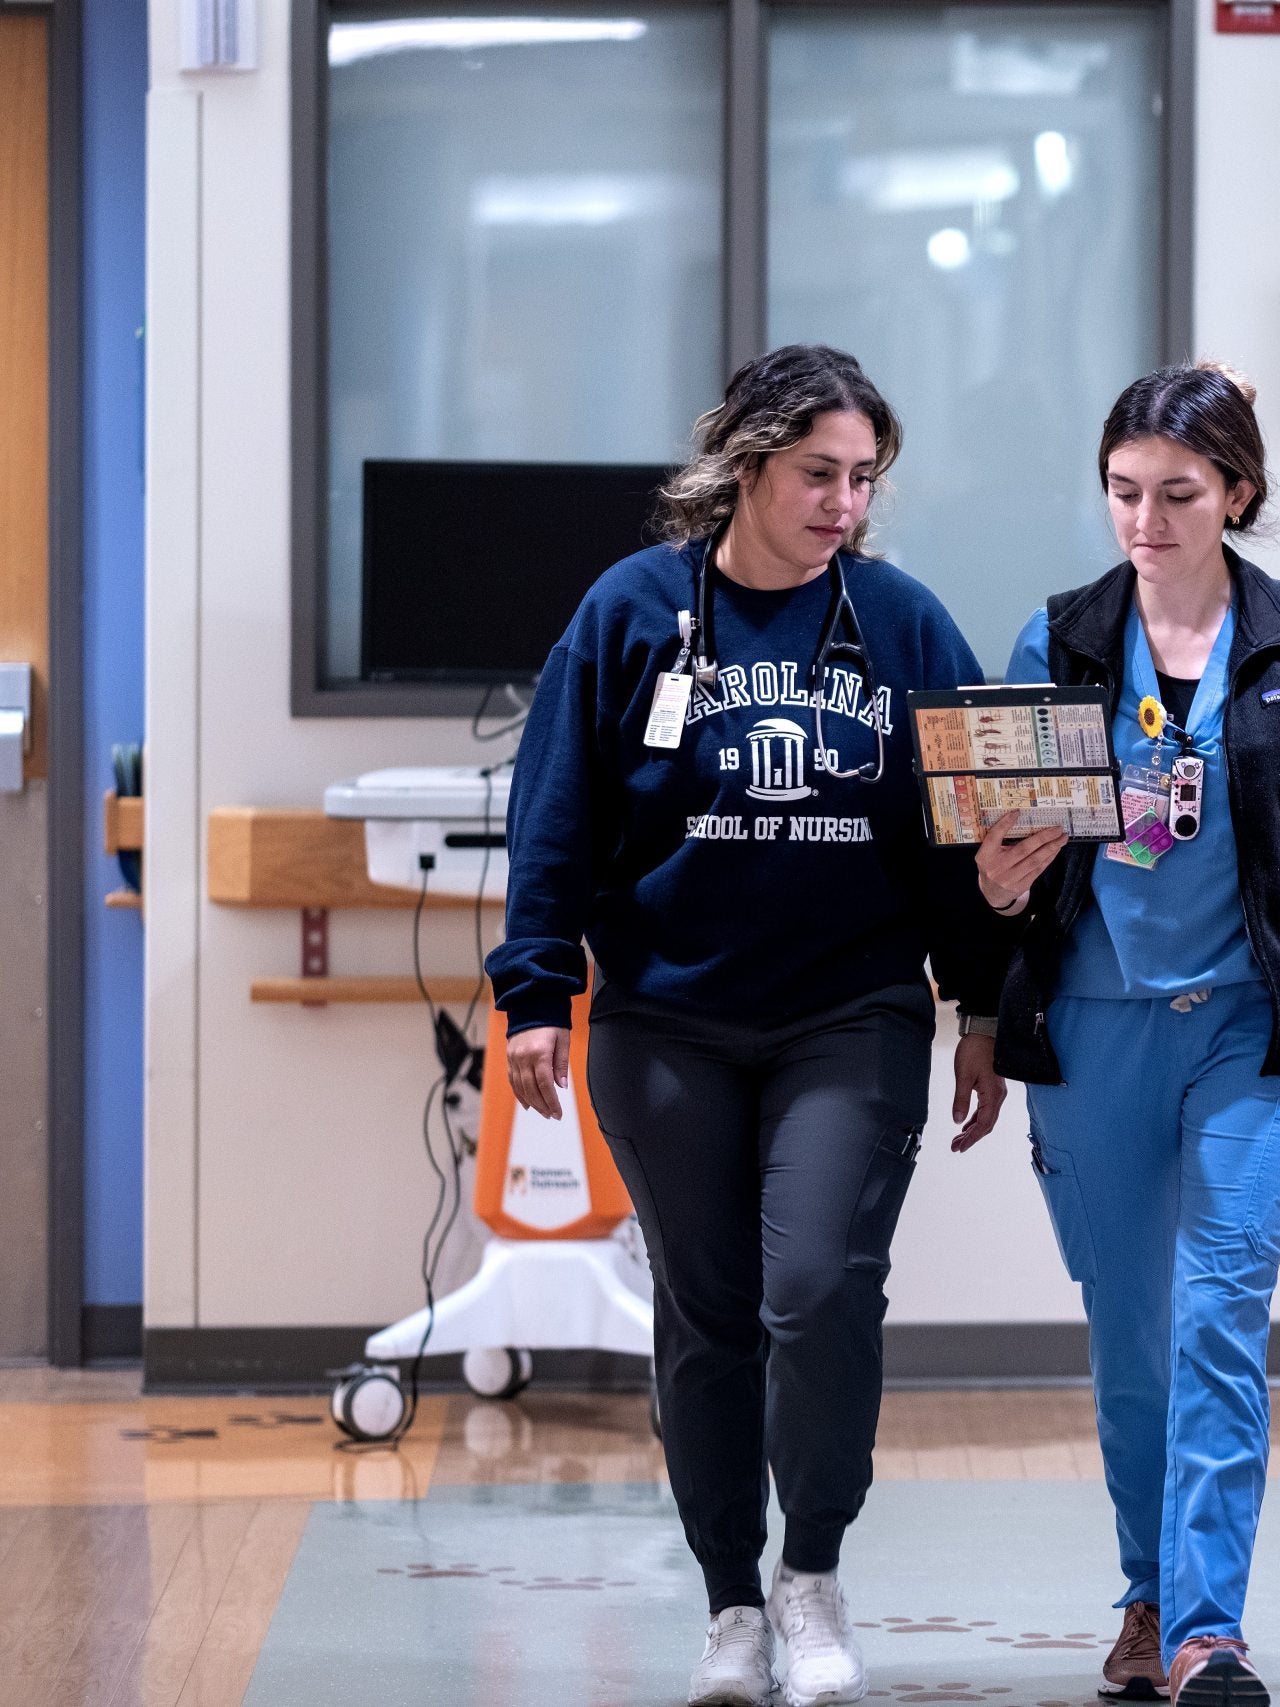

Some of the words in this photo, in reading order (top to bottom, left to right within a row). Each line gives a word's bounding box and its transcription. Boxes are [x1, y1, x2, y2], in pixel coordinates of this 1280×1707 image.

[685, 661, 894, 736] AROLINA
[718, 747, 740, 771] 19
[813, 748, 839, 771] 50
[685, 815, 749, 840] SHOOL
[754, 816, 783, 841] OF
[788, 816, 874, 842] NURSIN
